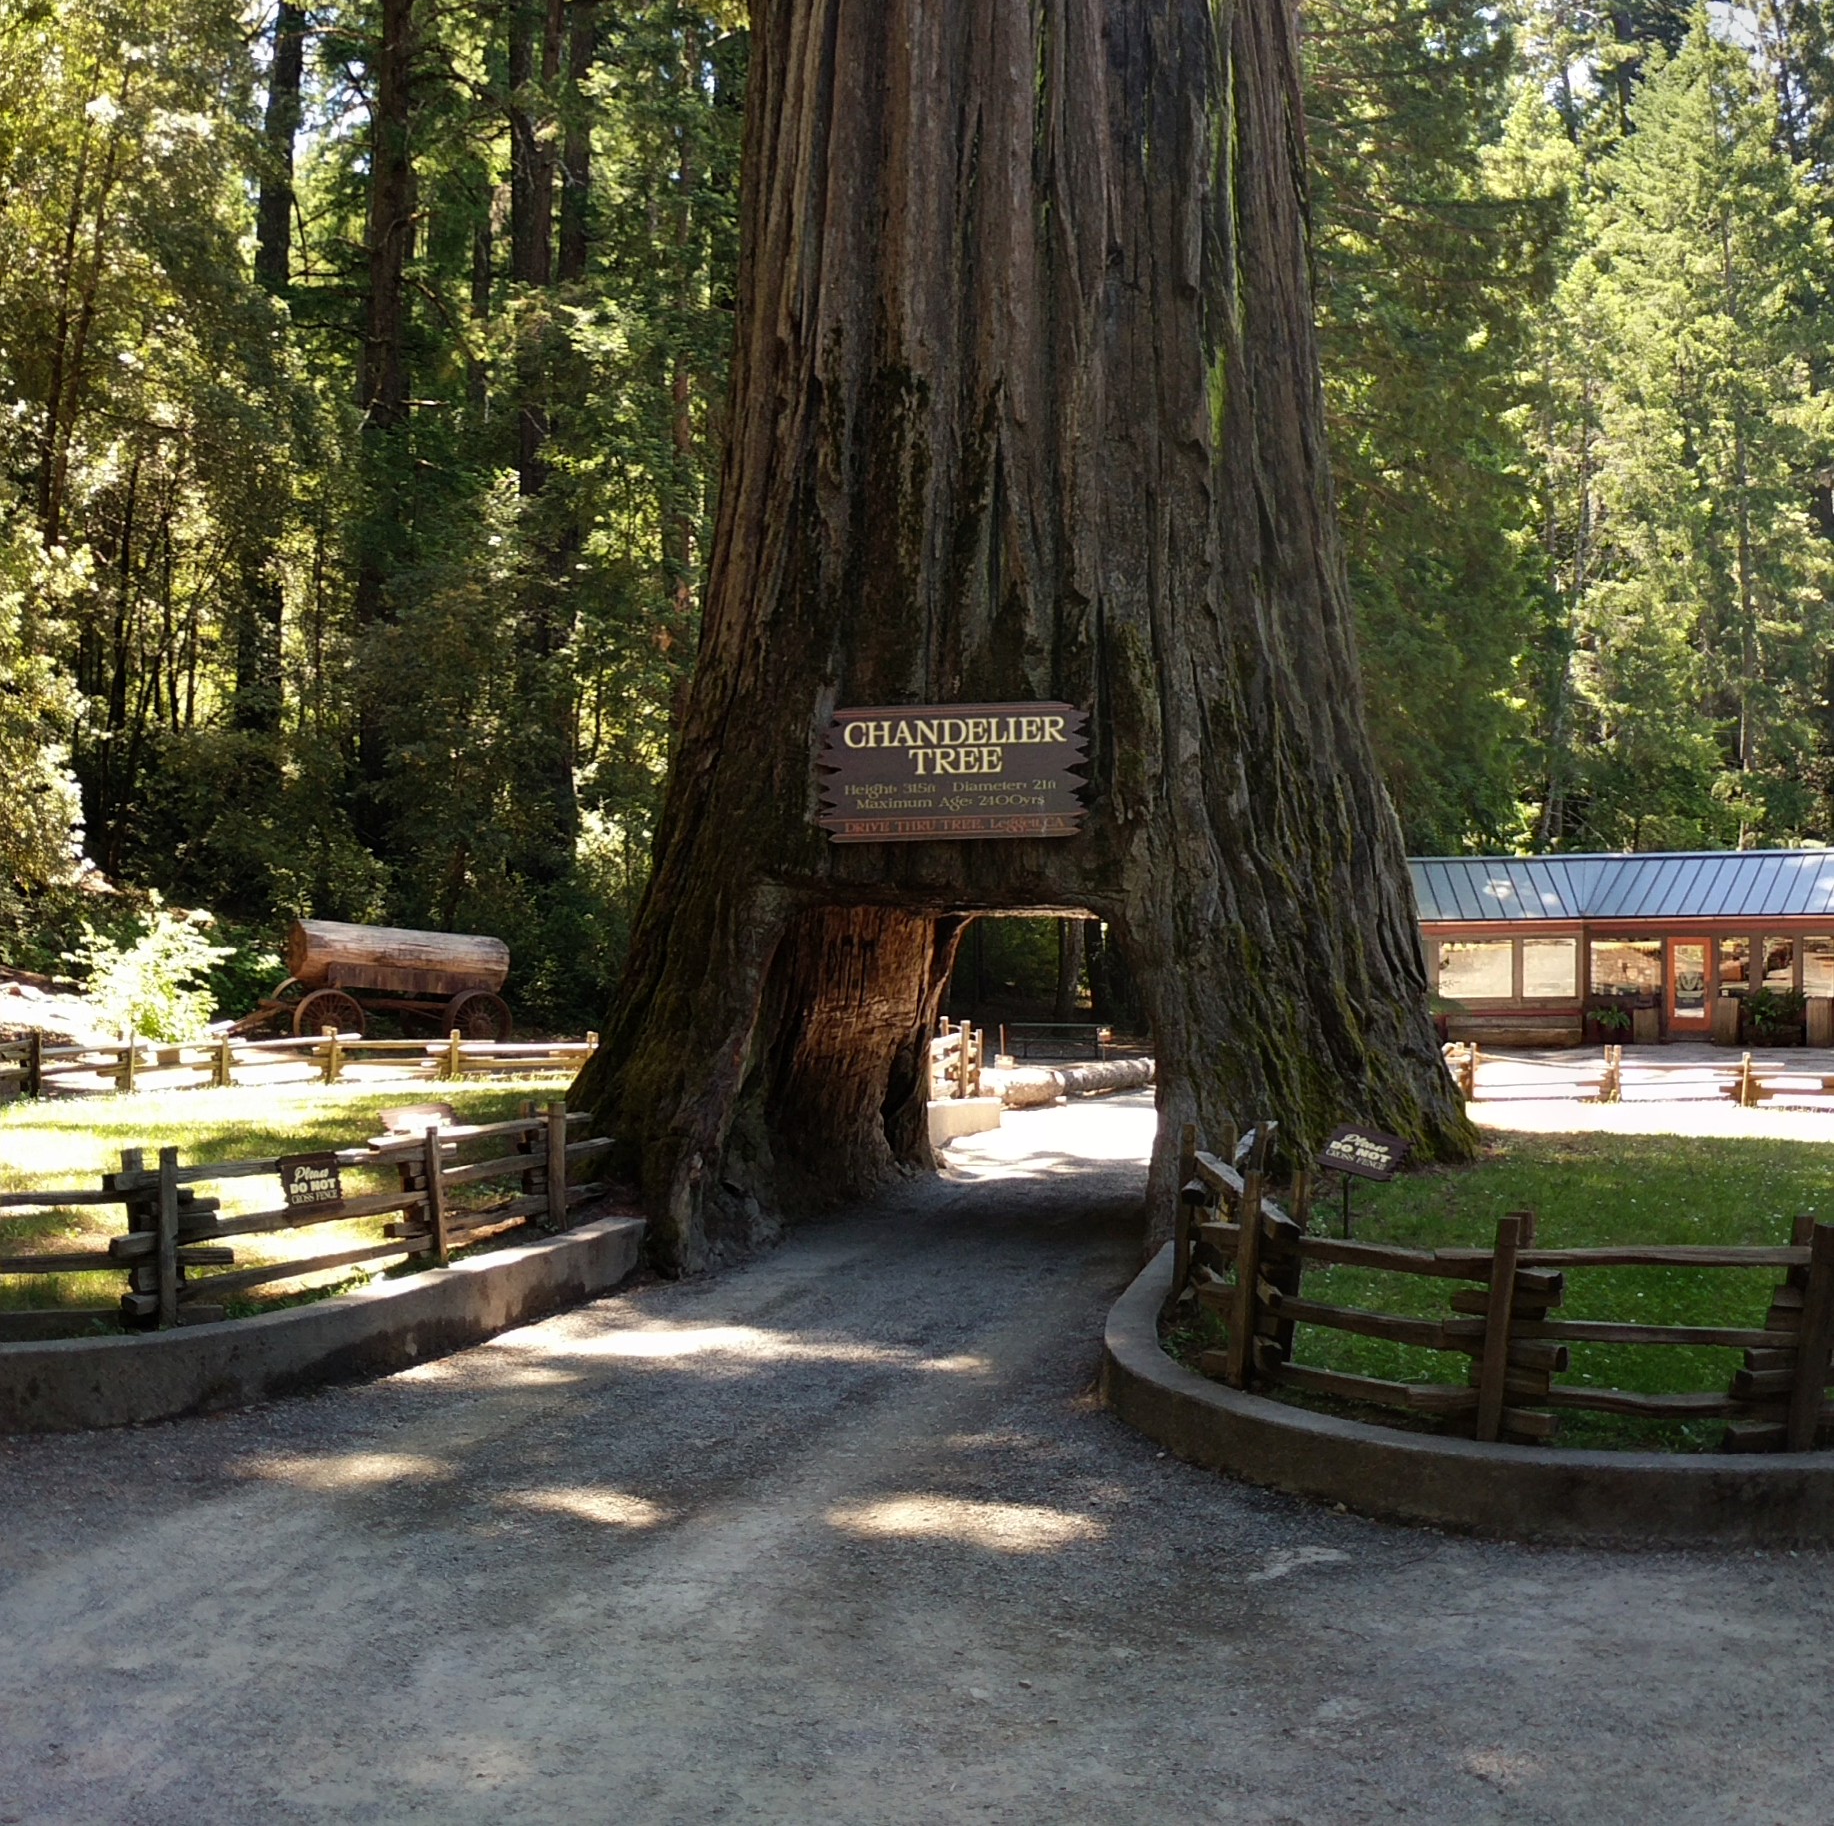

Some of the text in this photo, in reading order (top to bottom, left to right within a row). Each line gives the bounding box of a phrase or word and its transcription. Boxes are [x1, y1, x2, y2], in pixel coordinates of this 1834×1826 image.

[843, 716, 1067, 748] CHANDELIER
[908, 746, 1003, 775] TREE
[845, 782, 898, 800] Height:
[952, 780, 1028, 792] Diameter:
[856, 798, 933, 809] Maximum
[939, 796, 973, 812] Age:
[845, 821, 890, 833] DRIVE
[895, 819, 936, 831] THRU
[1330, 1140, 1392, 1163] DO NOT
[290, 1178, 336, 1194] DO NOT
[292, 1189, 338, 1204] CROSS FENCE
